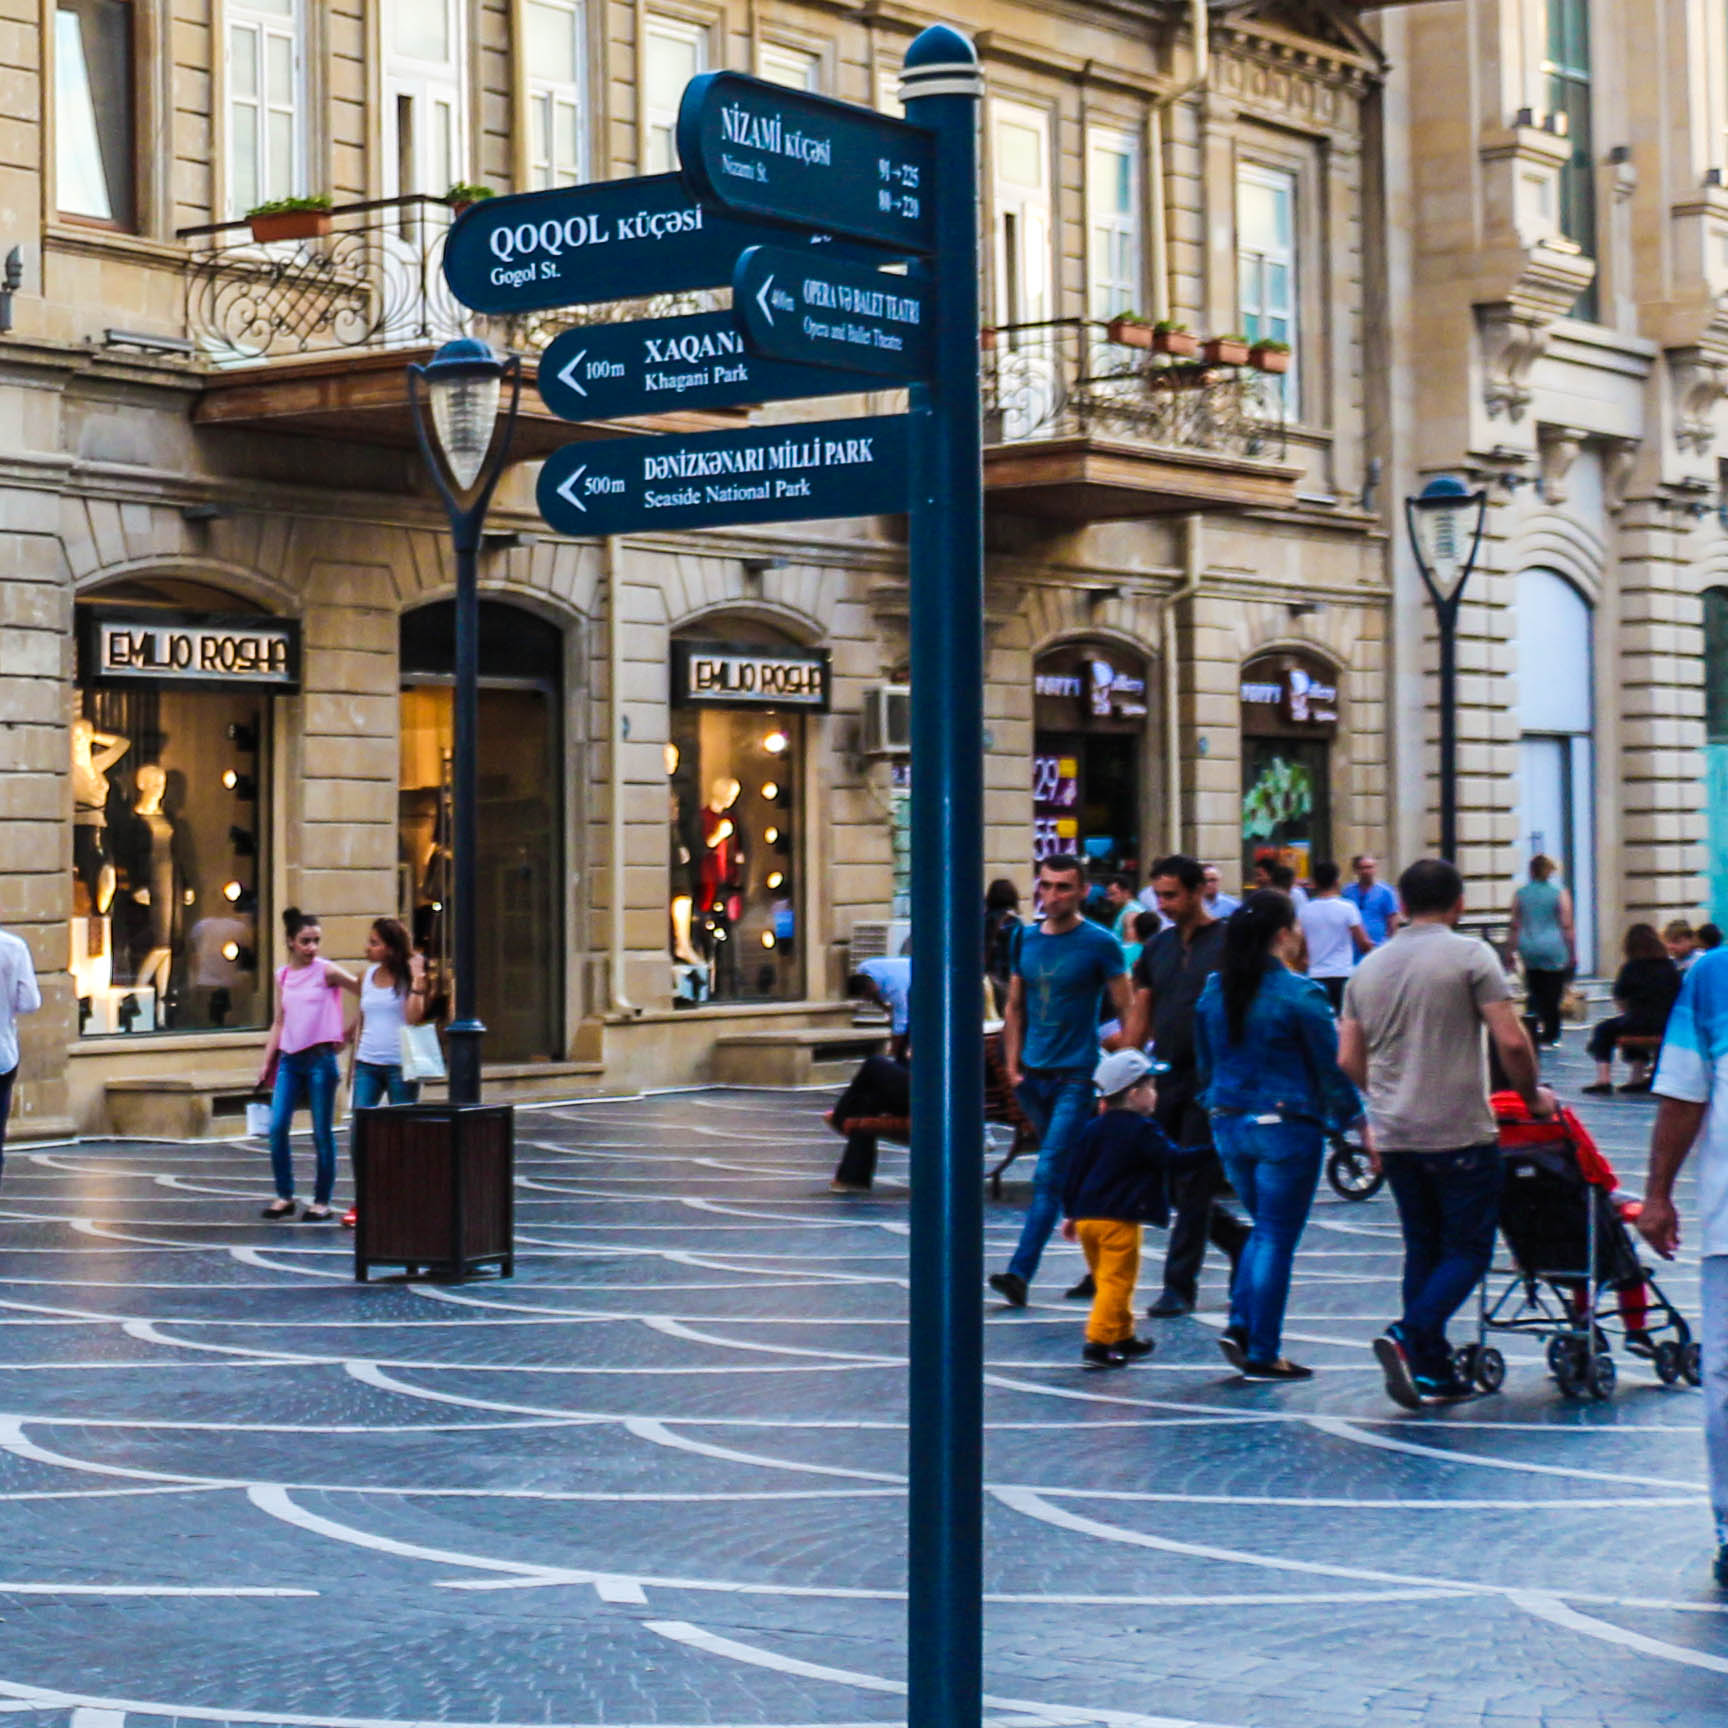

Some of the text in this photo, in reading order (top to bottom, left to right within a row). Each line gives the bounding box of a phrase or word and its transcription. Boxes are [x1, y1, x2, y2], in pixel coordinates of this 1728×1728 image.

[721, 102, 782, 154] NİZAMİ
[489, 214, 610, 262] QOQOL
[490, 261, 561, 288] Gogol St.
[802, 278, 837, 309] OPERA
[645, 363, 749, 392] Khagani Park
[584, 477, 626, 496] 500m
[825, 437, 874, 466] PARK
[644, 477, 812, 509] Seaside National Park
